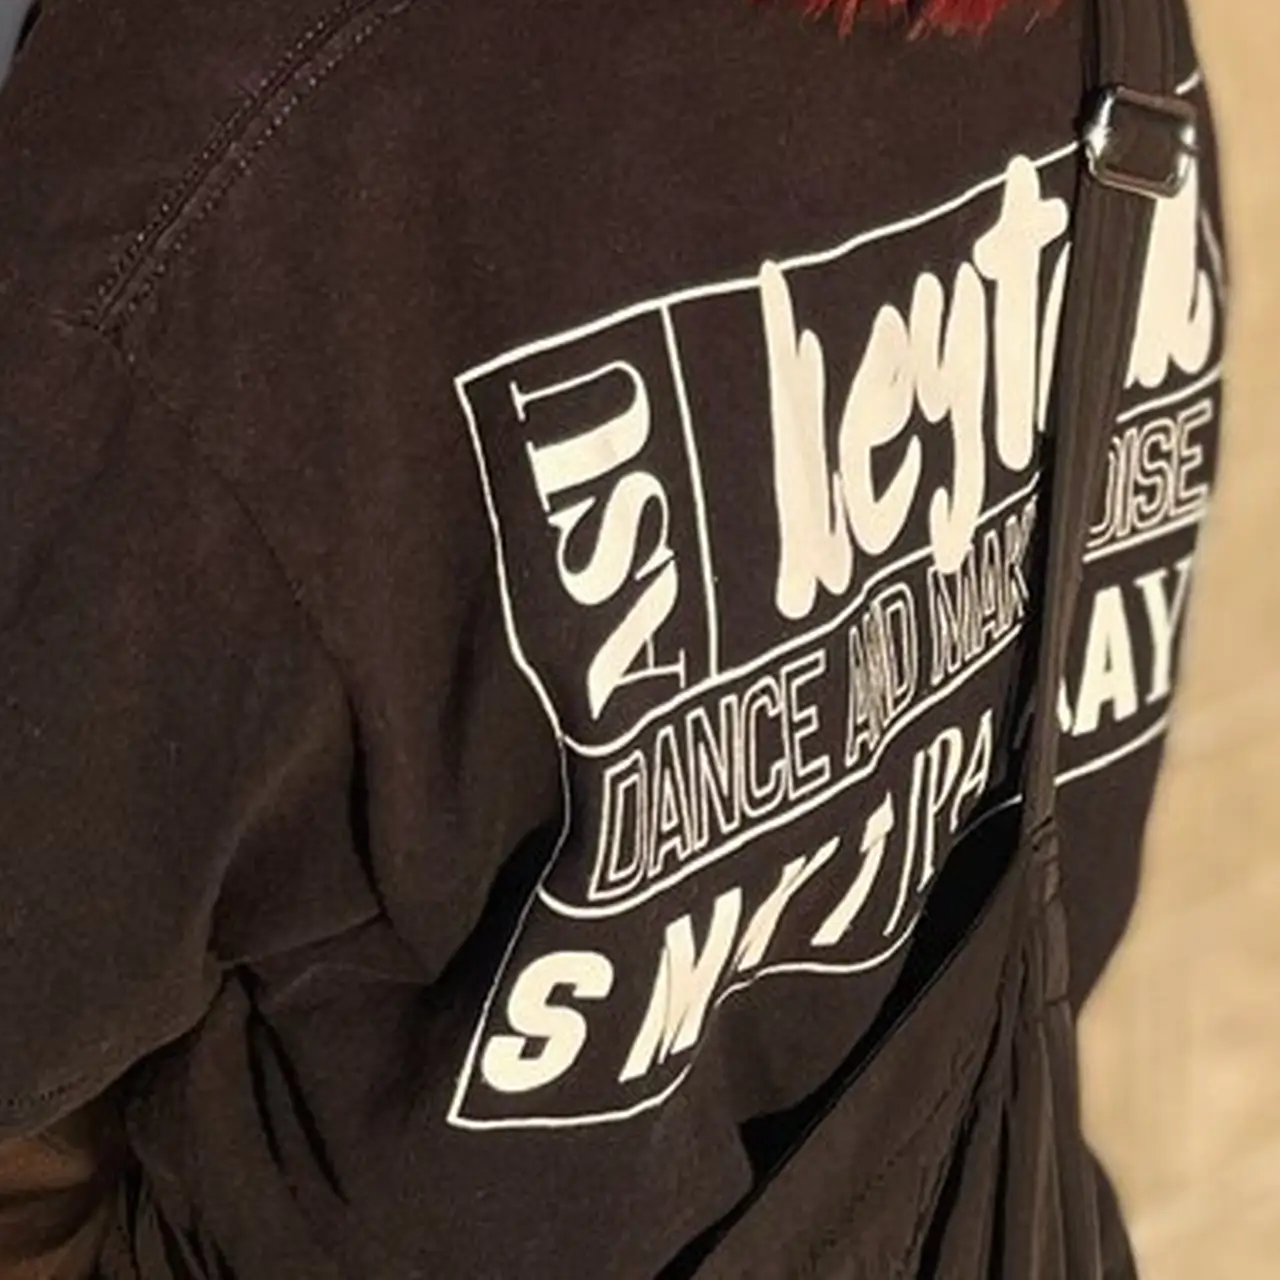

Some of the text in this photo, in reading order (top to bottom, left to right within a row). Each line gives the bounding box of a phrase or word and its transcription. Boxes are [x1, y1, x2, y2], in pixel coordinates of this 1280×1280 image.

[511, 360, 686, 721] ASU
[588, 648, 831, 902] DANCE
[927, 496, 1038, 687] MAK
